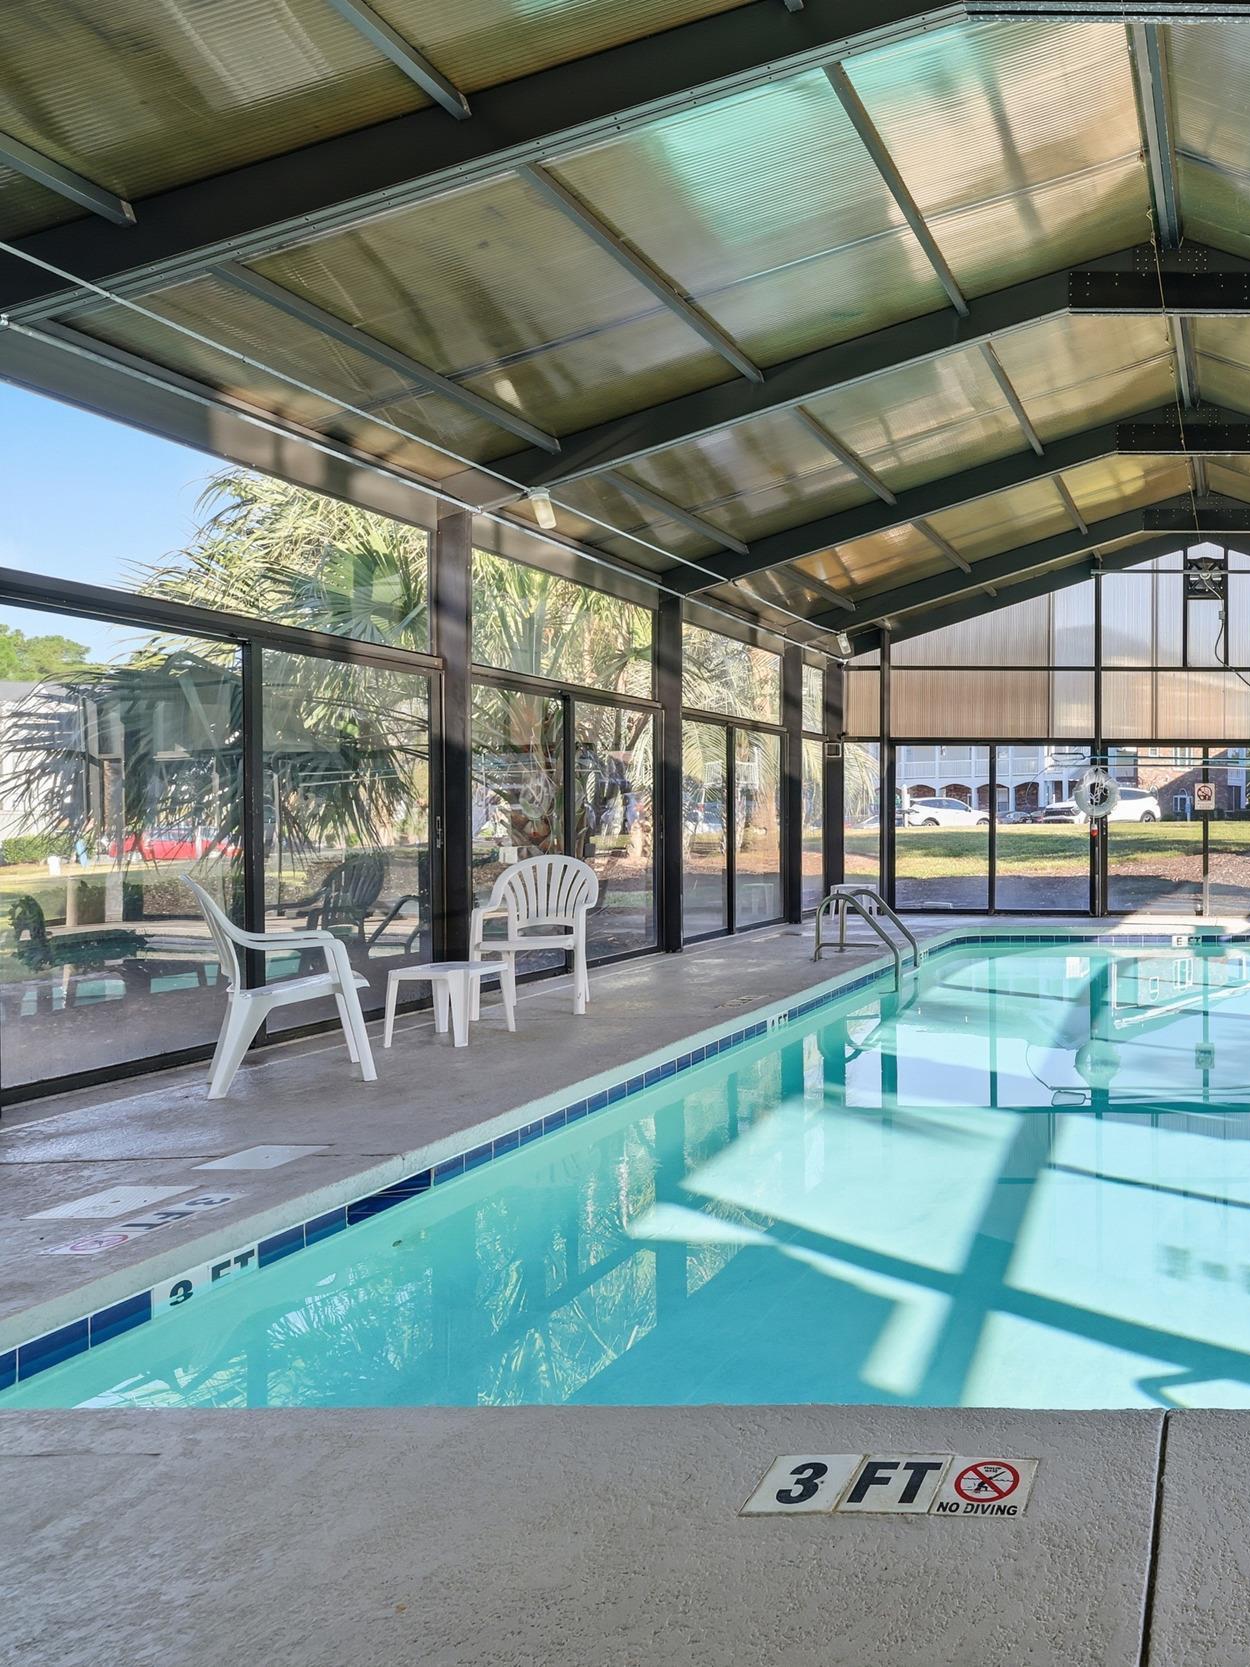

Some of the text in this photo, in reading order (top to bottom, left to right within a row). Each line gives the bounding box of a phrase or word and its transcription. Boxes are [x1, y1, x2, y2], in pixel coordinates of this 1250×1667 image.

[775, 1461, 943, 1504] 3 FT
[936, 1501, 1018, 1516] NO DIVING
